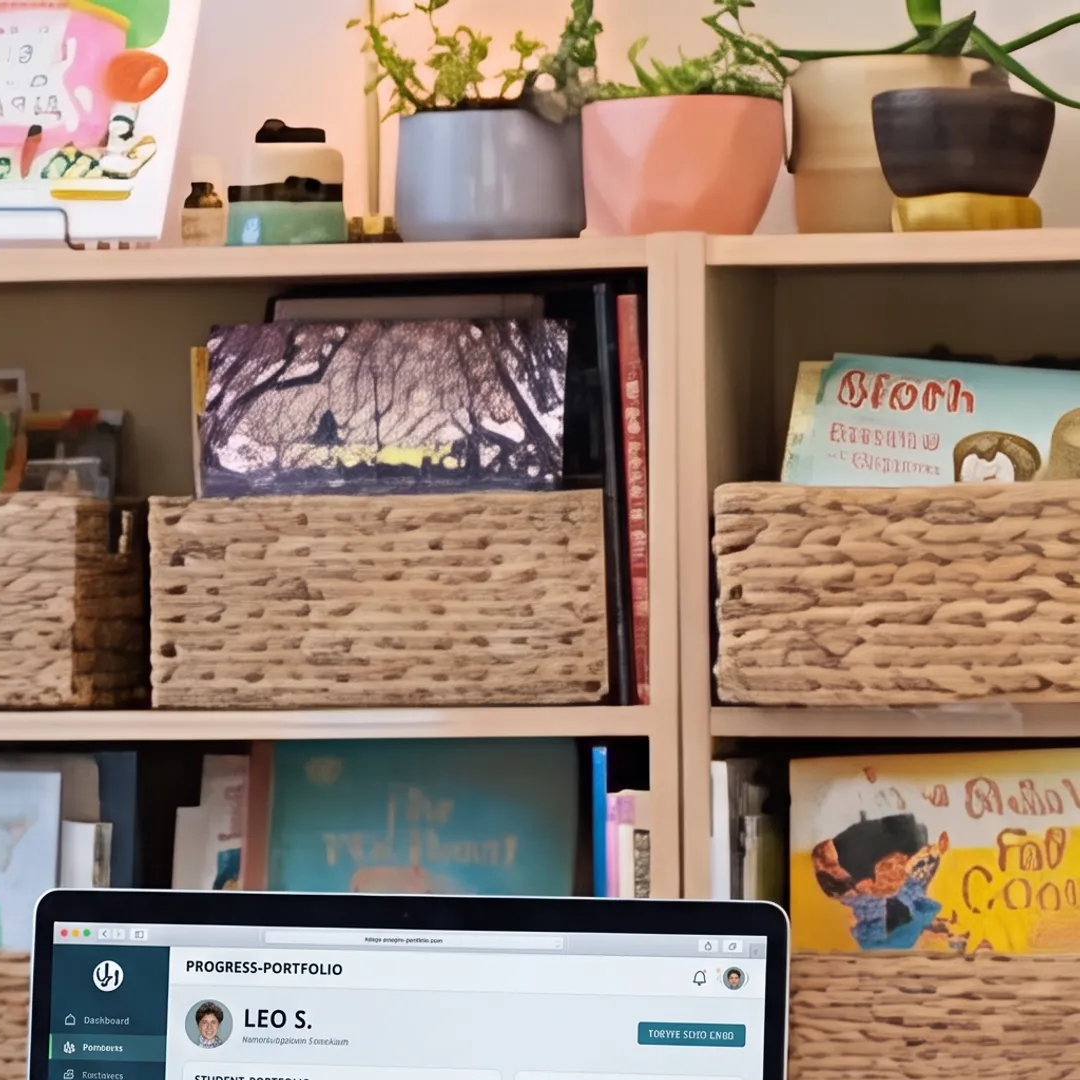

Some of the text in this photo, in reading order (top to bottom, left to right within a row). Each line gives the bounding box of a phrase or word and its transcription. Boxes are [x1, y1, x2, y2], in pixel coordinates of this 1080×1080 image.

[186, 960, 343, 976] PROGRESS-PORTFOLIO
[245, 1009, 312, 1029] LEO S.
